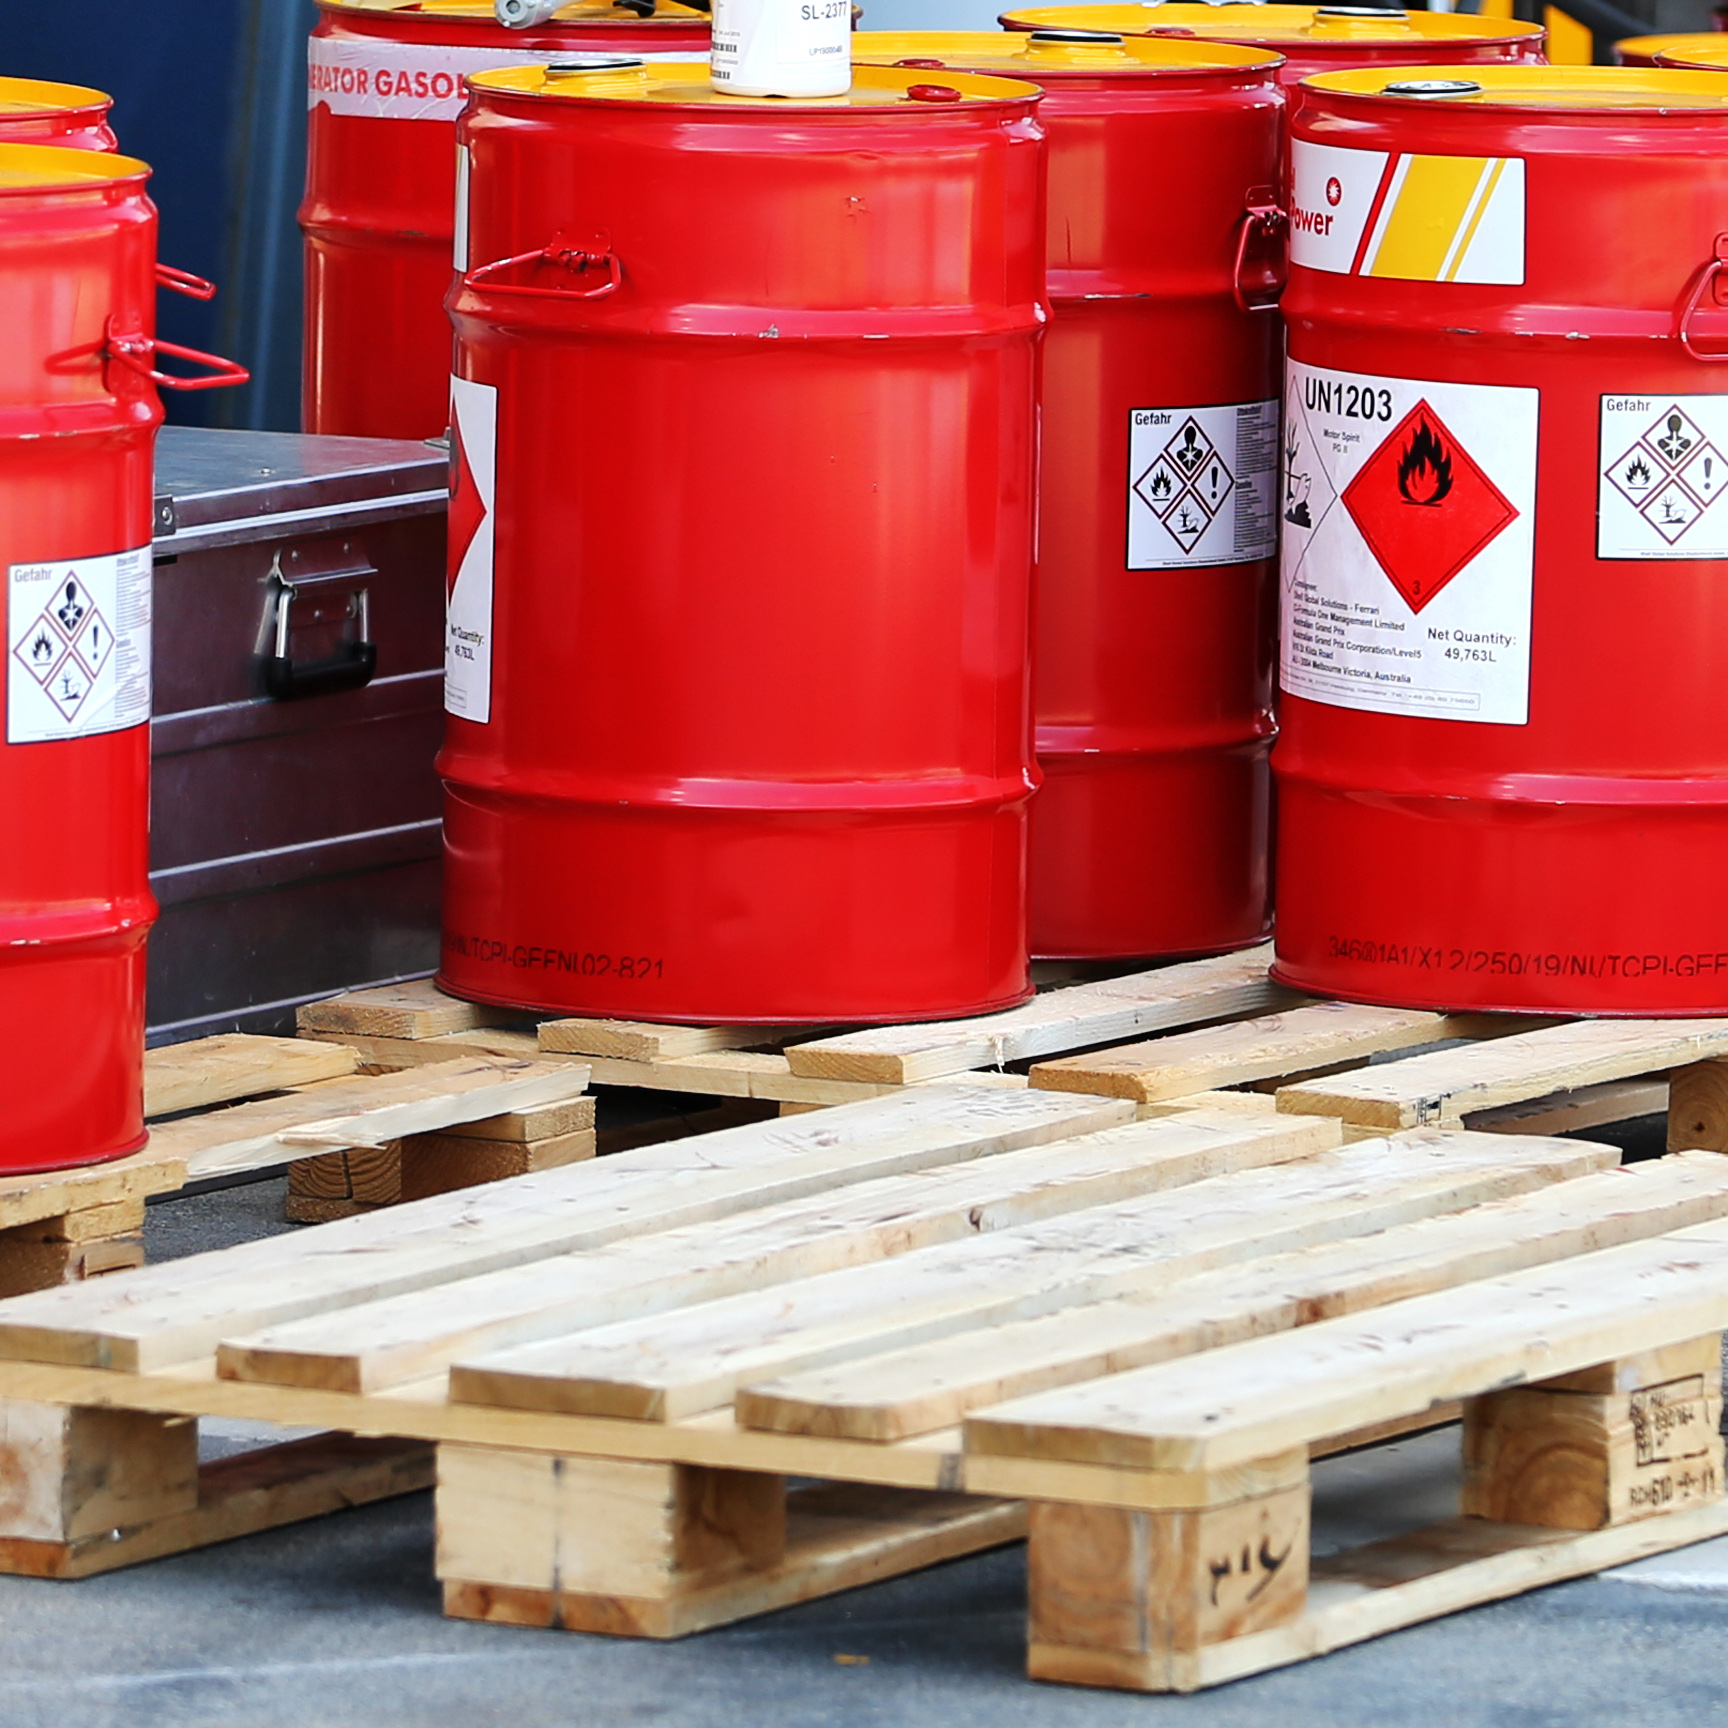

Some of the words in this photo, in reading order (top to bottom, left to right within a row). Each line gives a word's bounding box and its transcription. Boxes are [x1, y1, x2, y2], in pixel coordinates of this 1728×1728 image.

[801, 1, 847, 20] SL-2377
[309, 63, 368, 94] ERATOR
[375, 69, 469, 100] GASOL
[1290, 196, 1333, 236] Power
[1305, 376, 1392, 422] UN1203
[1606, 399, 1651, 412] Gefahr
[1135, 412, 1172, 425] Gefahr
[1323, 429, 1340, 441] Motor
[1341, 431, 1360, 444] Spirit
[14, 568, 52, 583] Gefahr
[1412, 580, 1420, 595] 3
[1321, 597, 1348, 610] Solutions
[1355, 603, 1379, 614] Ferrari
[1330, 613, 1373, 626] Management
[1375, 619, 1405, 631] Limited
[1428, 627, 1449, 642] Net
[1454, 630, 1517, 647] Quantity:
[1444, 647, 1497, 663] 49,763L
[1343, 666, 1372, 680] Victoria,
[1375, 672, 1411, 683] Australia
